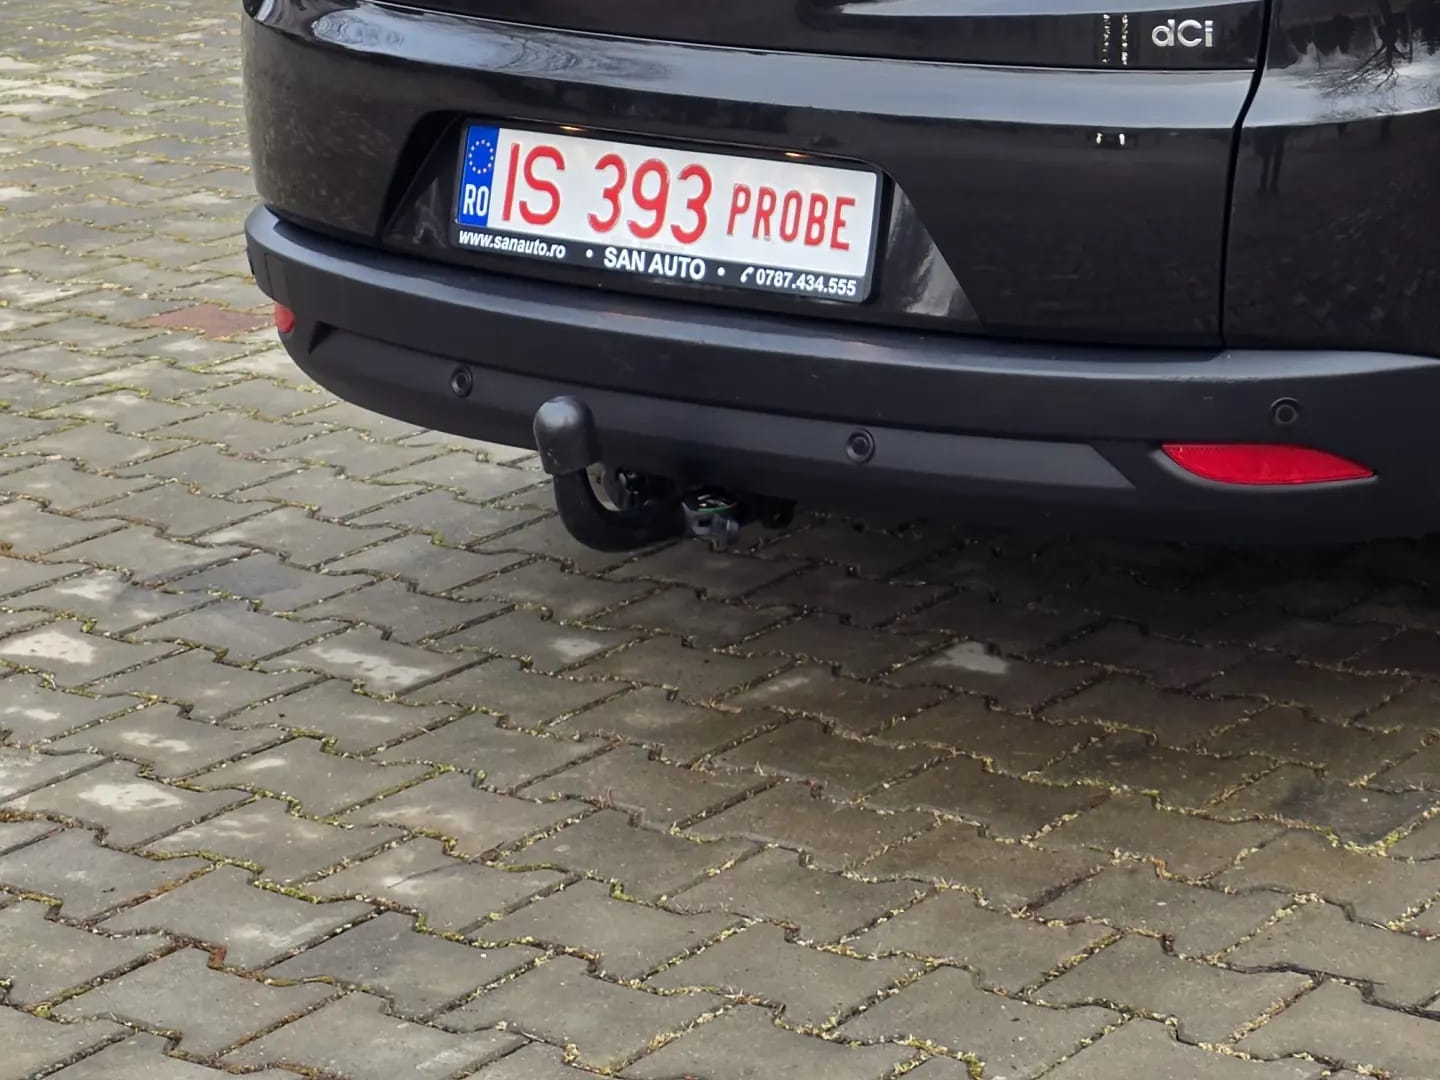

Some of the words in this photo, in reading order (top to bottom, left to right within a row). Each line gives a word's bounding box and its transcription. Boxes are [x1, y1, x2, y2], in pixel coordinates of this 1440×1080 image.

[1152, 19, 1213, 47] dCi
[463, 183, 489, 217] RO
[502, 142, 566, 226] IS
[587, 153, 712, 244] 393
[726, 183, 856, 252] PROBE
[459, 230, 566, 260] www.sanauto.ro
[603, 246, 645, 273] SAN
[648, 253, 706, 280] AUTO
[756, 269, 857, 297] 0787.434.555
